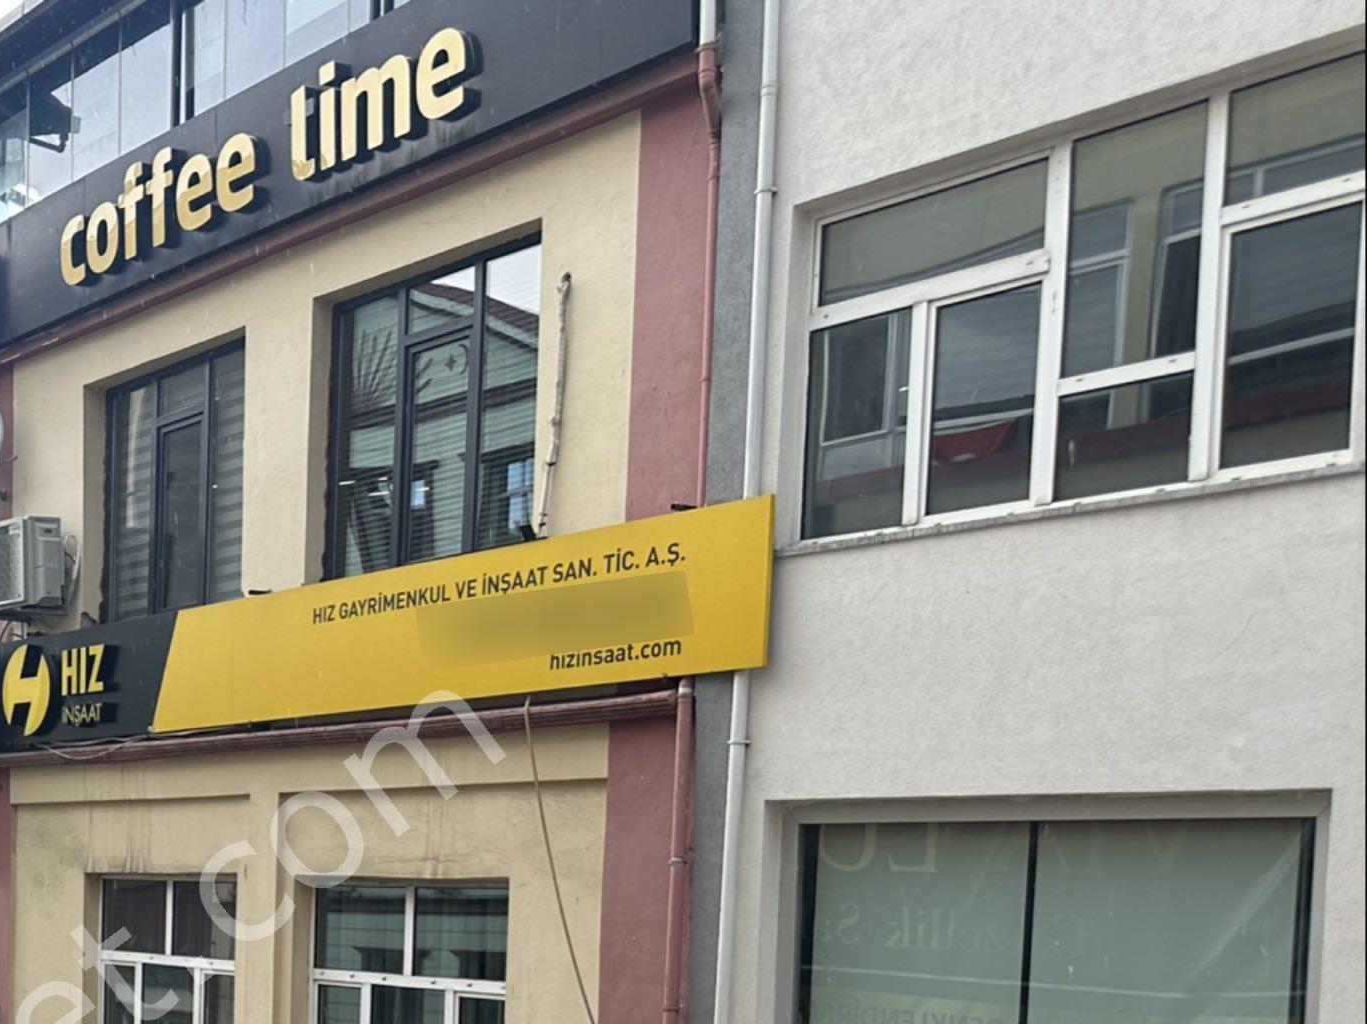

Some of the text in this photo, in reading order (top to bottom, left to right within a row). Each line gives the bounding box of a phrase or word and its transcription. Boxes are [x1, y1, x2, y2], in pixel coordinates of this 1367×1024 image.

[59, 26, 472, 287] coffee time
[312, 604, 335, 625] HIZ
[338, 581, 451, 620] GAYRİMENKUL
[455, 578, 477, 600] VE
[481, 565, 549, 597] İNŞAAT
[552, 557, 597, 584] SAN.
[603, 547, 640, 575] TİC.
[645, 541, 686, 568] A.Ş.
[61, 643, 105, 696] HIZ
[61, 702, 103, 726] İNŞAAT
